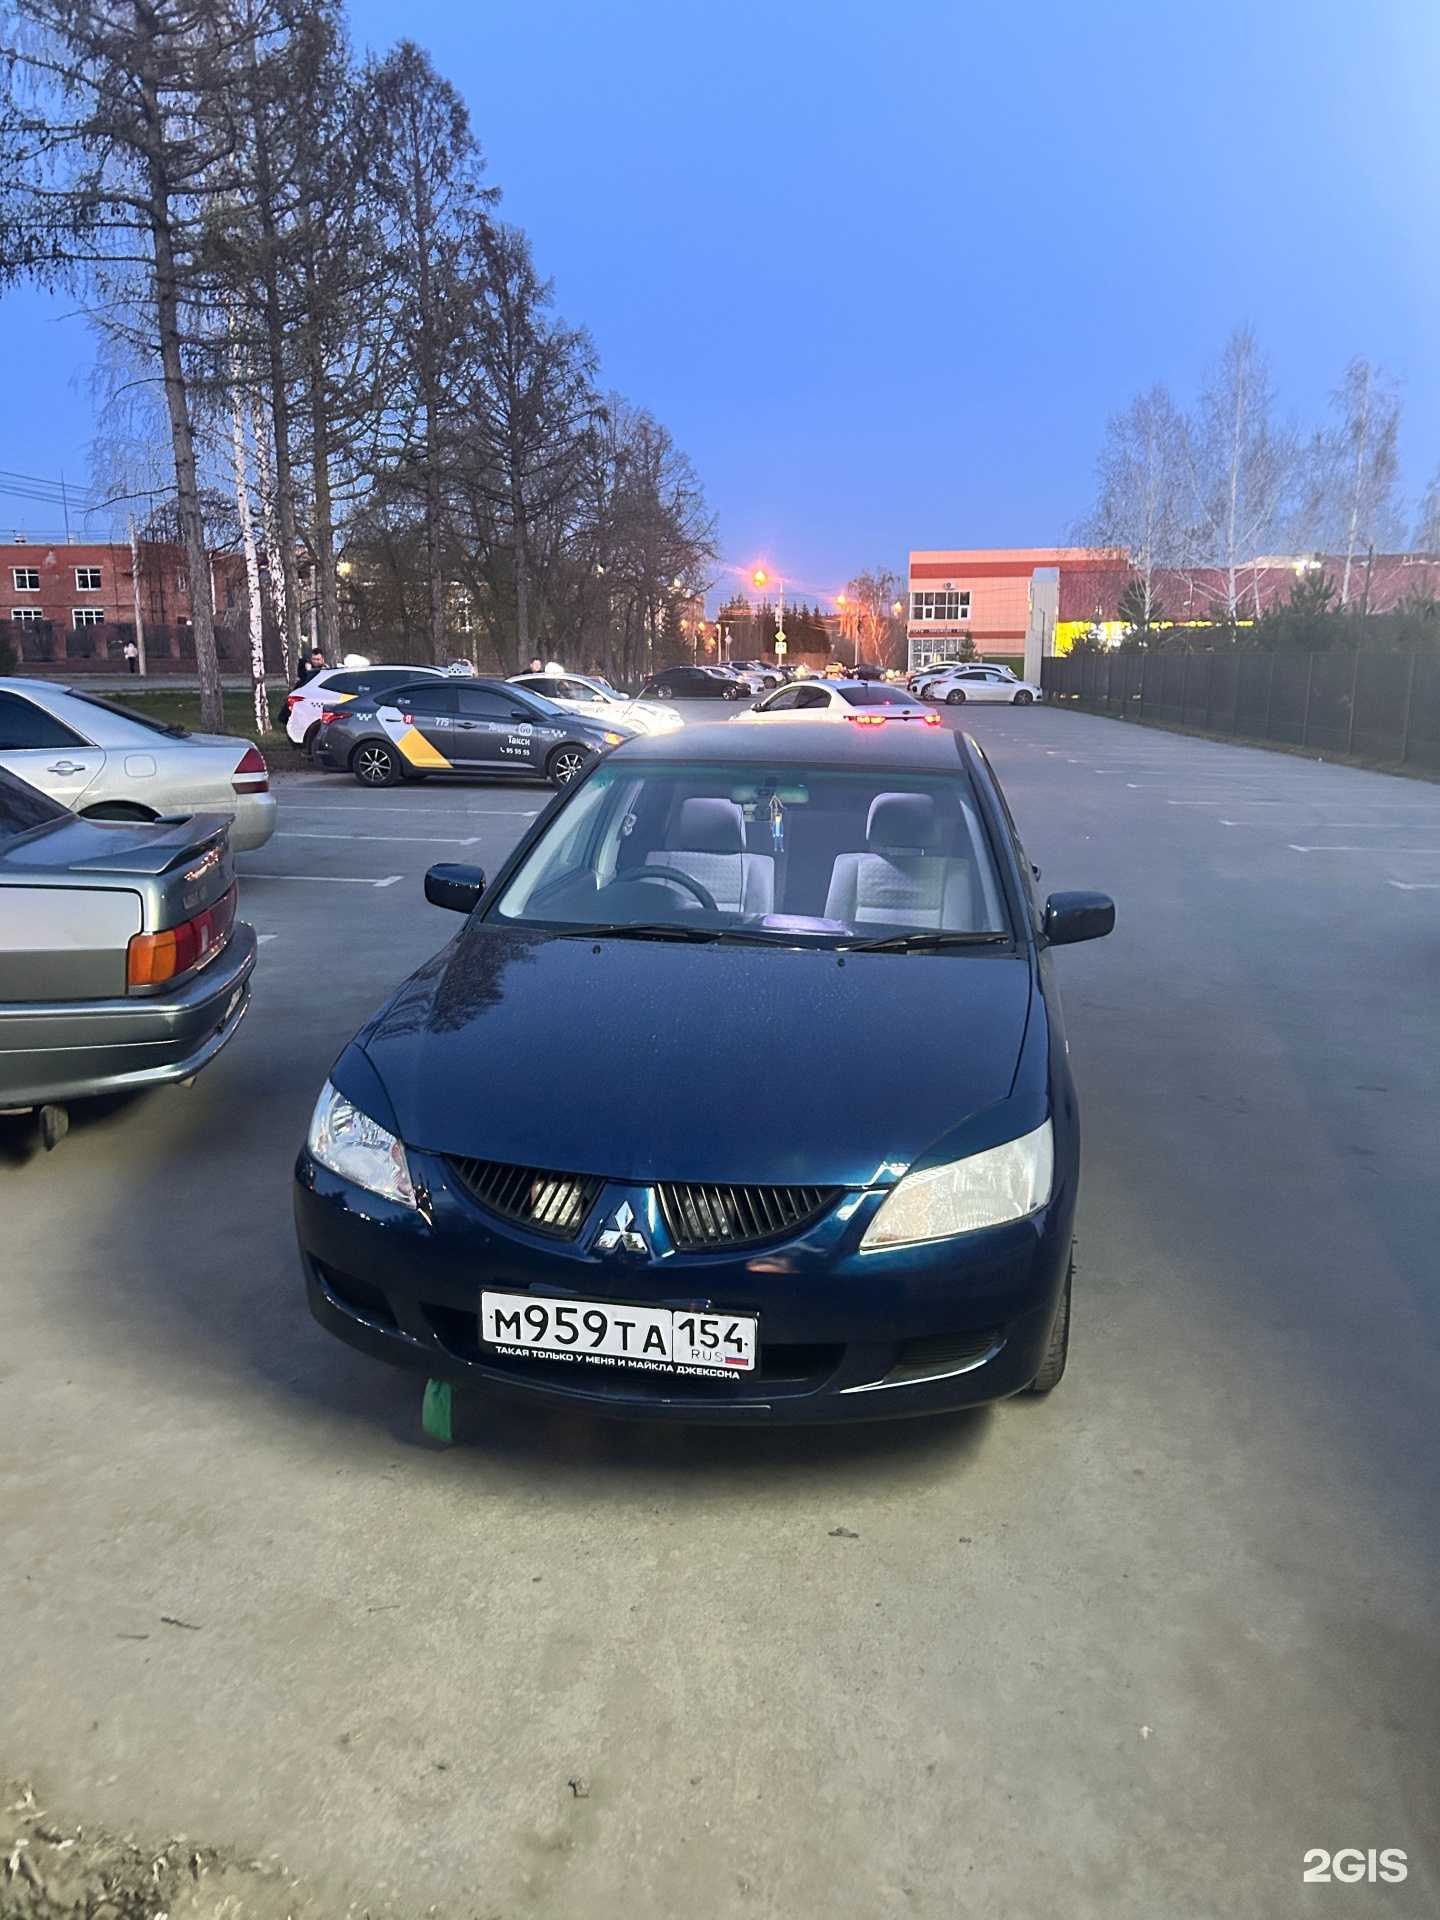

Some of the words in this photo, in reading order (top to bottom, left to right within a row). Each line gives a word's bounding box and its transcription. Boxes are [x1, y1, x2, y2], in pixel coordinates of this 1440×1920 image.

[508, 735, 530, 746] Такси
[678, 1319, 743, 1353] 154
[495, 1346, 529, 1357] ТАКАЯ
[532, 1350, 574, 1361] ТОЛЬКО
[586, 1356, 615, 1366] МЕНЯ
[617, 1359, 626, 1367] И
[628, 1360, 674, 1372] МАЙКЛА
[676, 1366, 740, 1380] ДЖЕКСОНА
[691, 1348, 724, 1363] RUS
